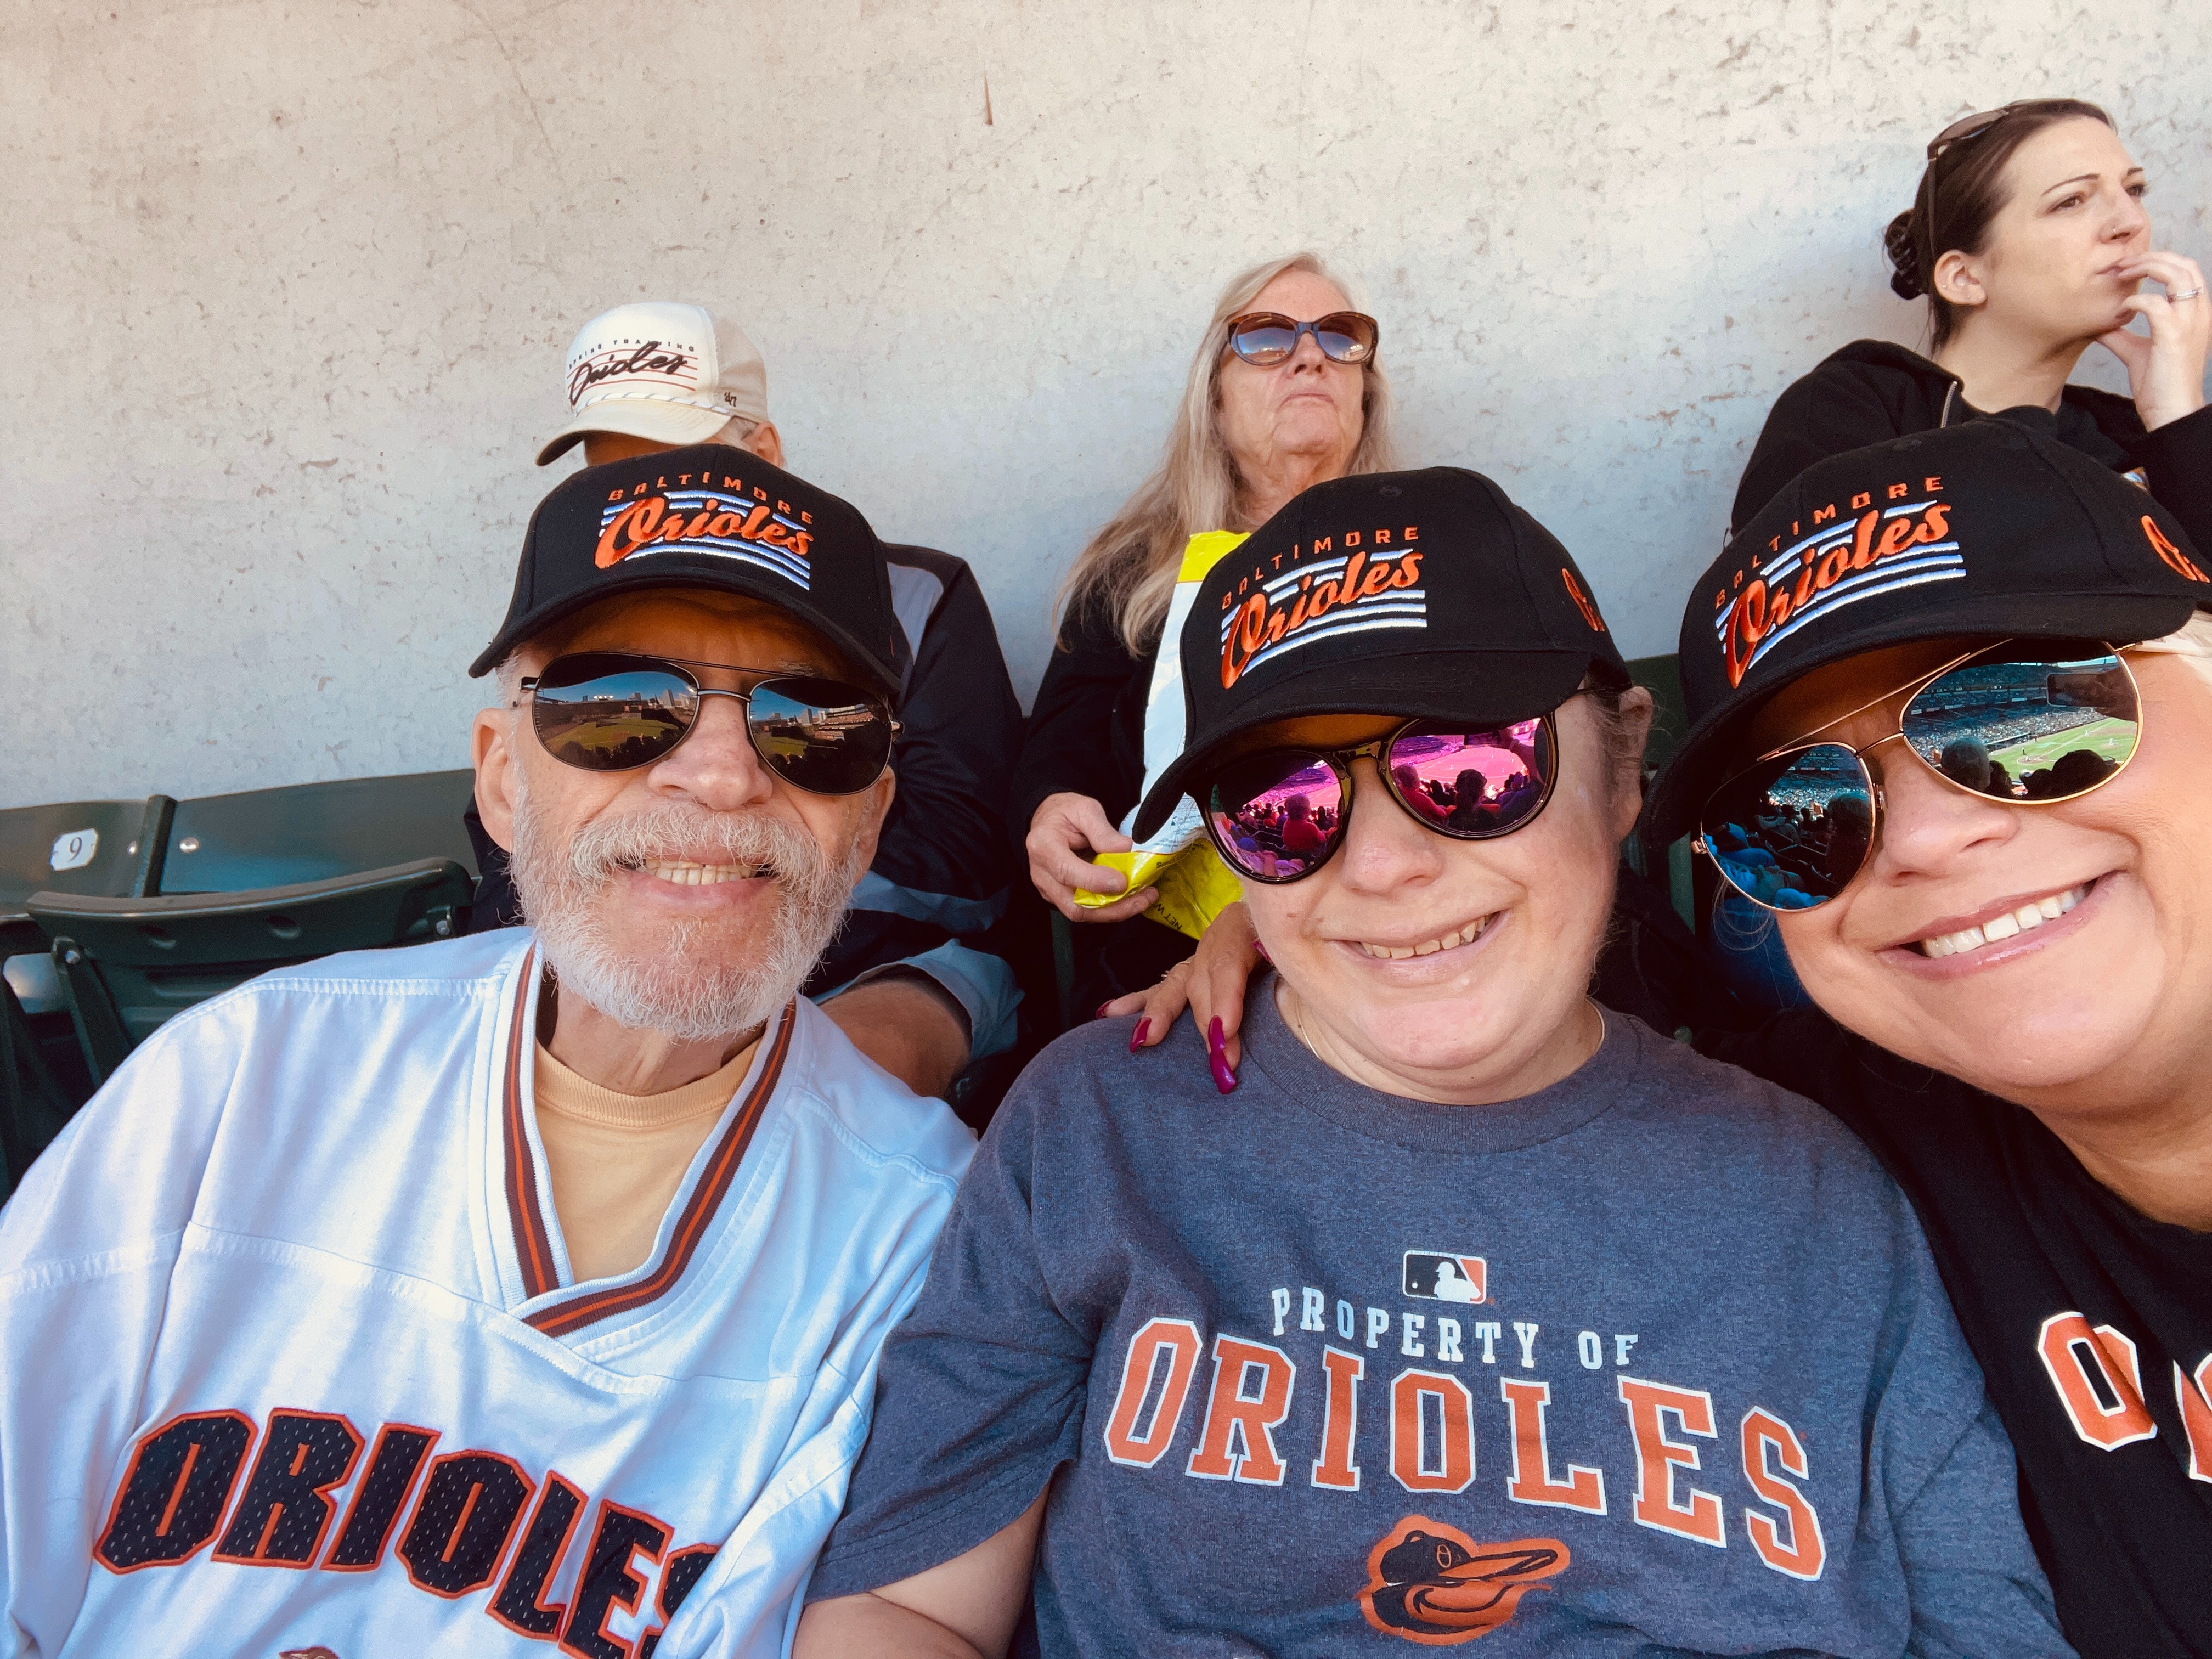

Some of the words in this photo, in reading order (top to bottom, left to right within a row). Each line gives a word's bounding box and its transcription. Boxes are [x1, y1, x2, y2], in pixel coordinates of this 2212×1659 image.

[569, 343, 602, 370] SPRING
[613, 338, 695, 352] TRAINING
[570, 341, 688, 406] Orioles
[594, 496, 814, 569] Orioles
[608, 471, 813, 524] BALTIMORE
[1222, 526, 1419, 610] BALTIMORE
[1716, 476, 1942, 608] BALTIMORE
[1221, 551, 1424, 690] Orioles
[1725, 503, 1951, 689] Orioles
[66, 836, 83, 862] 9
[1164, 912, 1182, 930] NET
[1271, 1286, 1539, 1368] PROPERTY
[1577, 1330, 1639, 1370] OF
[1103, 1317, 1827, 1581] ORIOLES
